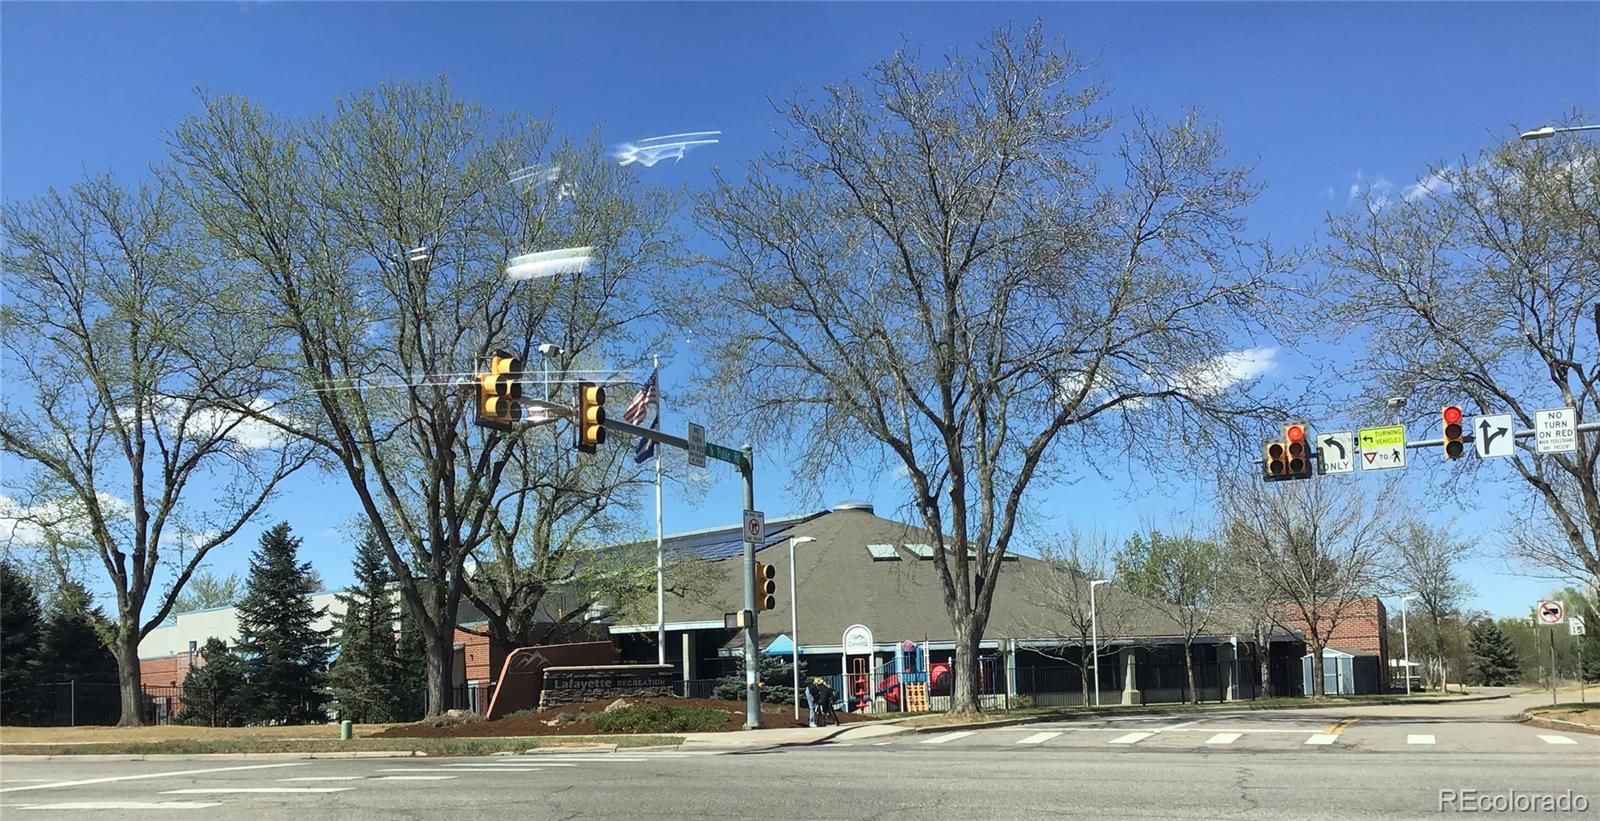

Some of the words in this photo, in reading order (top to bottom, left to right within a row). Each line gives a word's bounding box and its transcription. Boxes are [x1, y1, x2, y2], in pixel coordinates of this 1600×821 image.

[1548, 411, 1562, 419] NO
[1544, 421, 1567, 429] TURN
[1374, 429, 1401, 437] TURNING
[1539, 431, 1551, 439] ON
[1555, 429, 1573, 437] RED
[1376, 437, 1401, 445] VEHICLES
[1324, 462, 1349, 471] ONLY
[1573, 626, 1583, 634] 15
[554, 678, 612, 690] Lafayette
[616, 678, 665, 687] RECREATION
